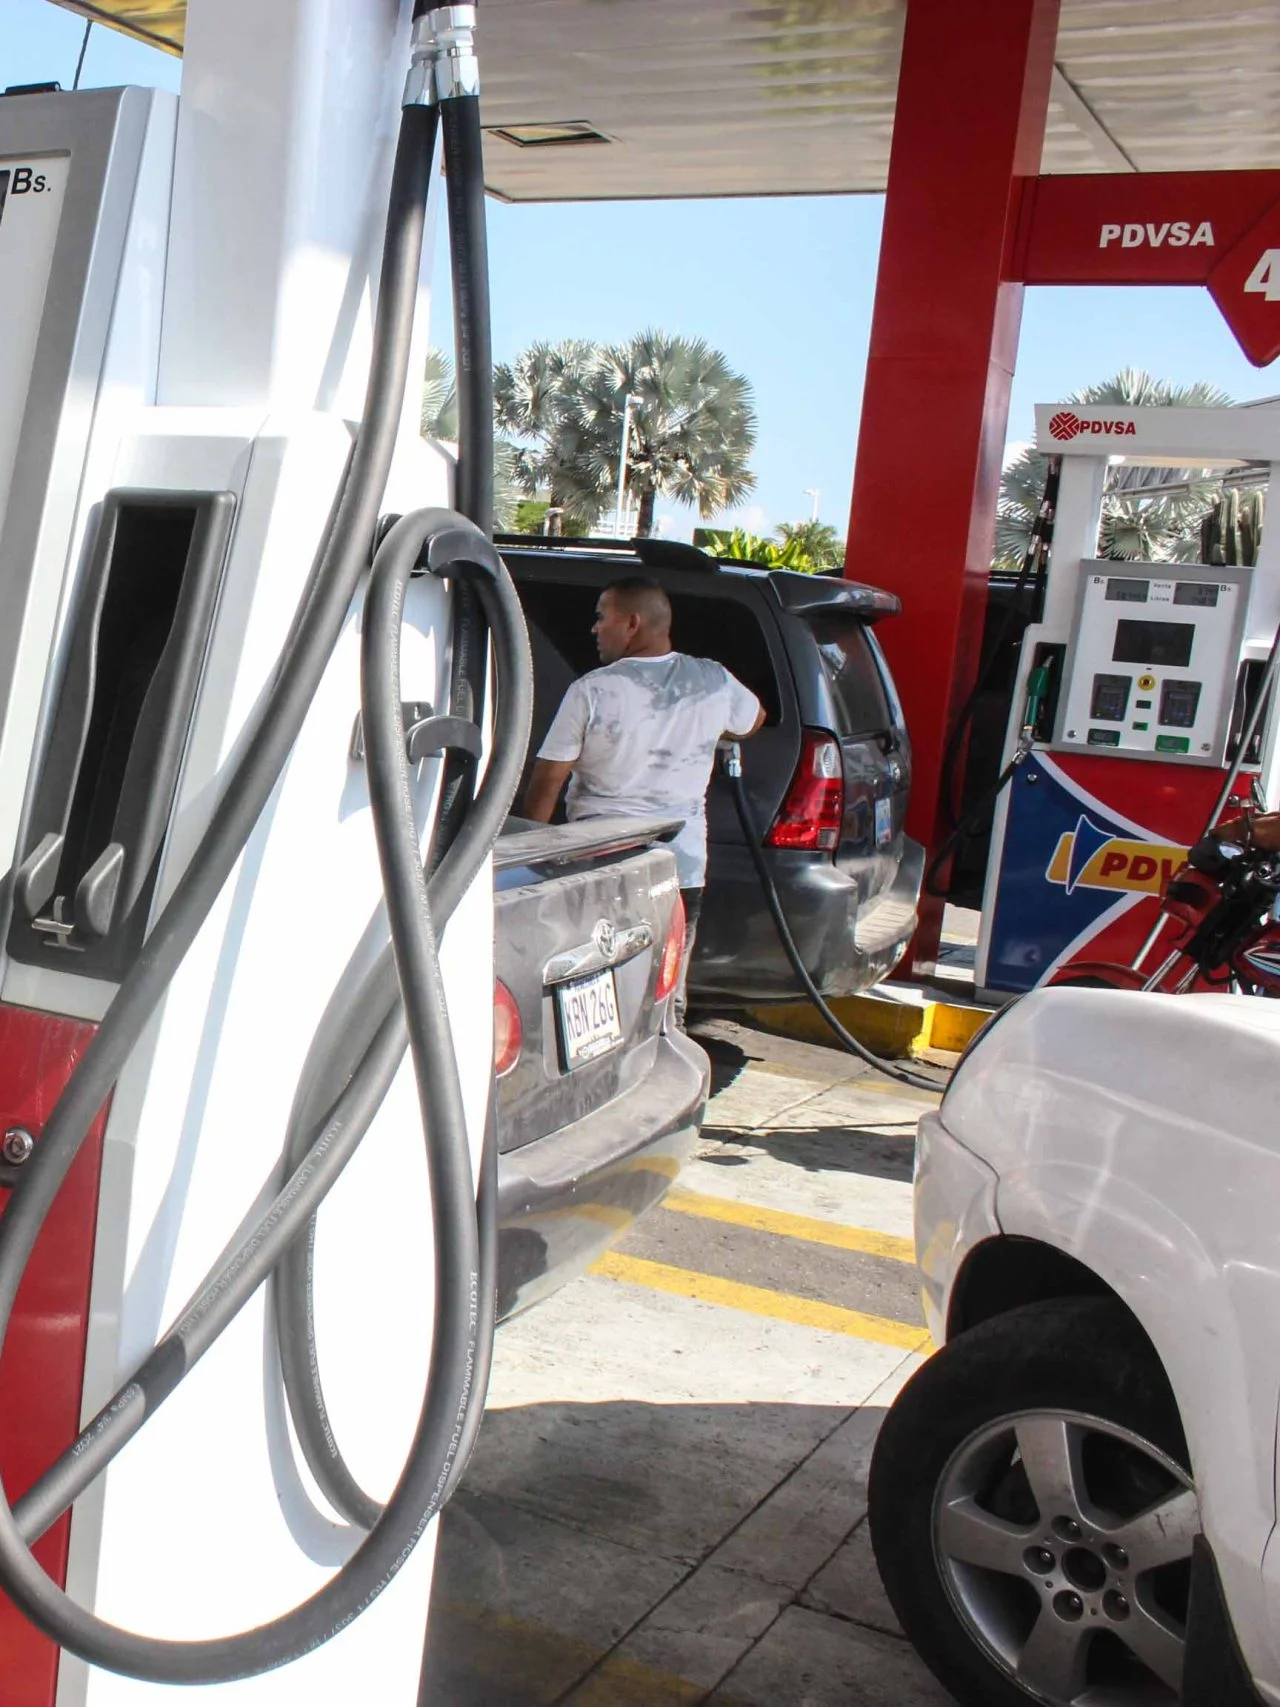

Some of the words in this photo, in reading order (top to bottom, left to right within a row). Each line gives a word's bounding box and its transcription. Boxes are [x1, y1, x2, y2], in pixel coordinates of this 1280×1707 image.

[10, 168, 51, 194] Bs.
[1099, 222, 1215, 248] PDVSA
[1079, 421, 1136, 435] PDVSA
[446, 1422, 462, 1459] FUEL
[412, 1460, 453, 1536] DISPENSER
